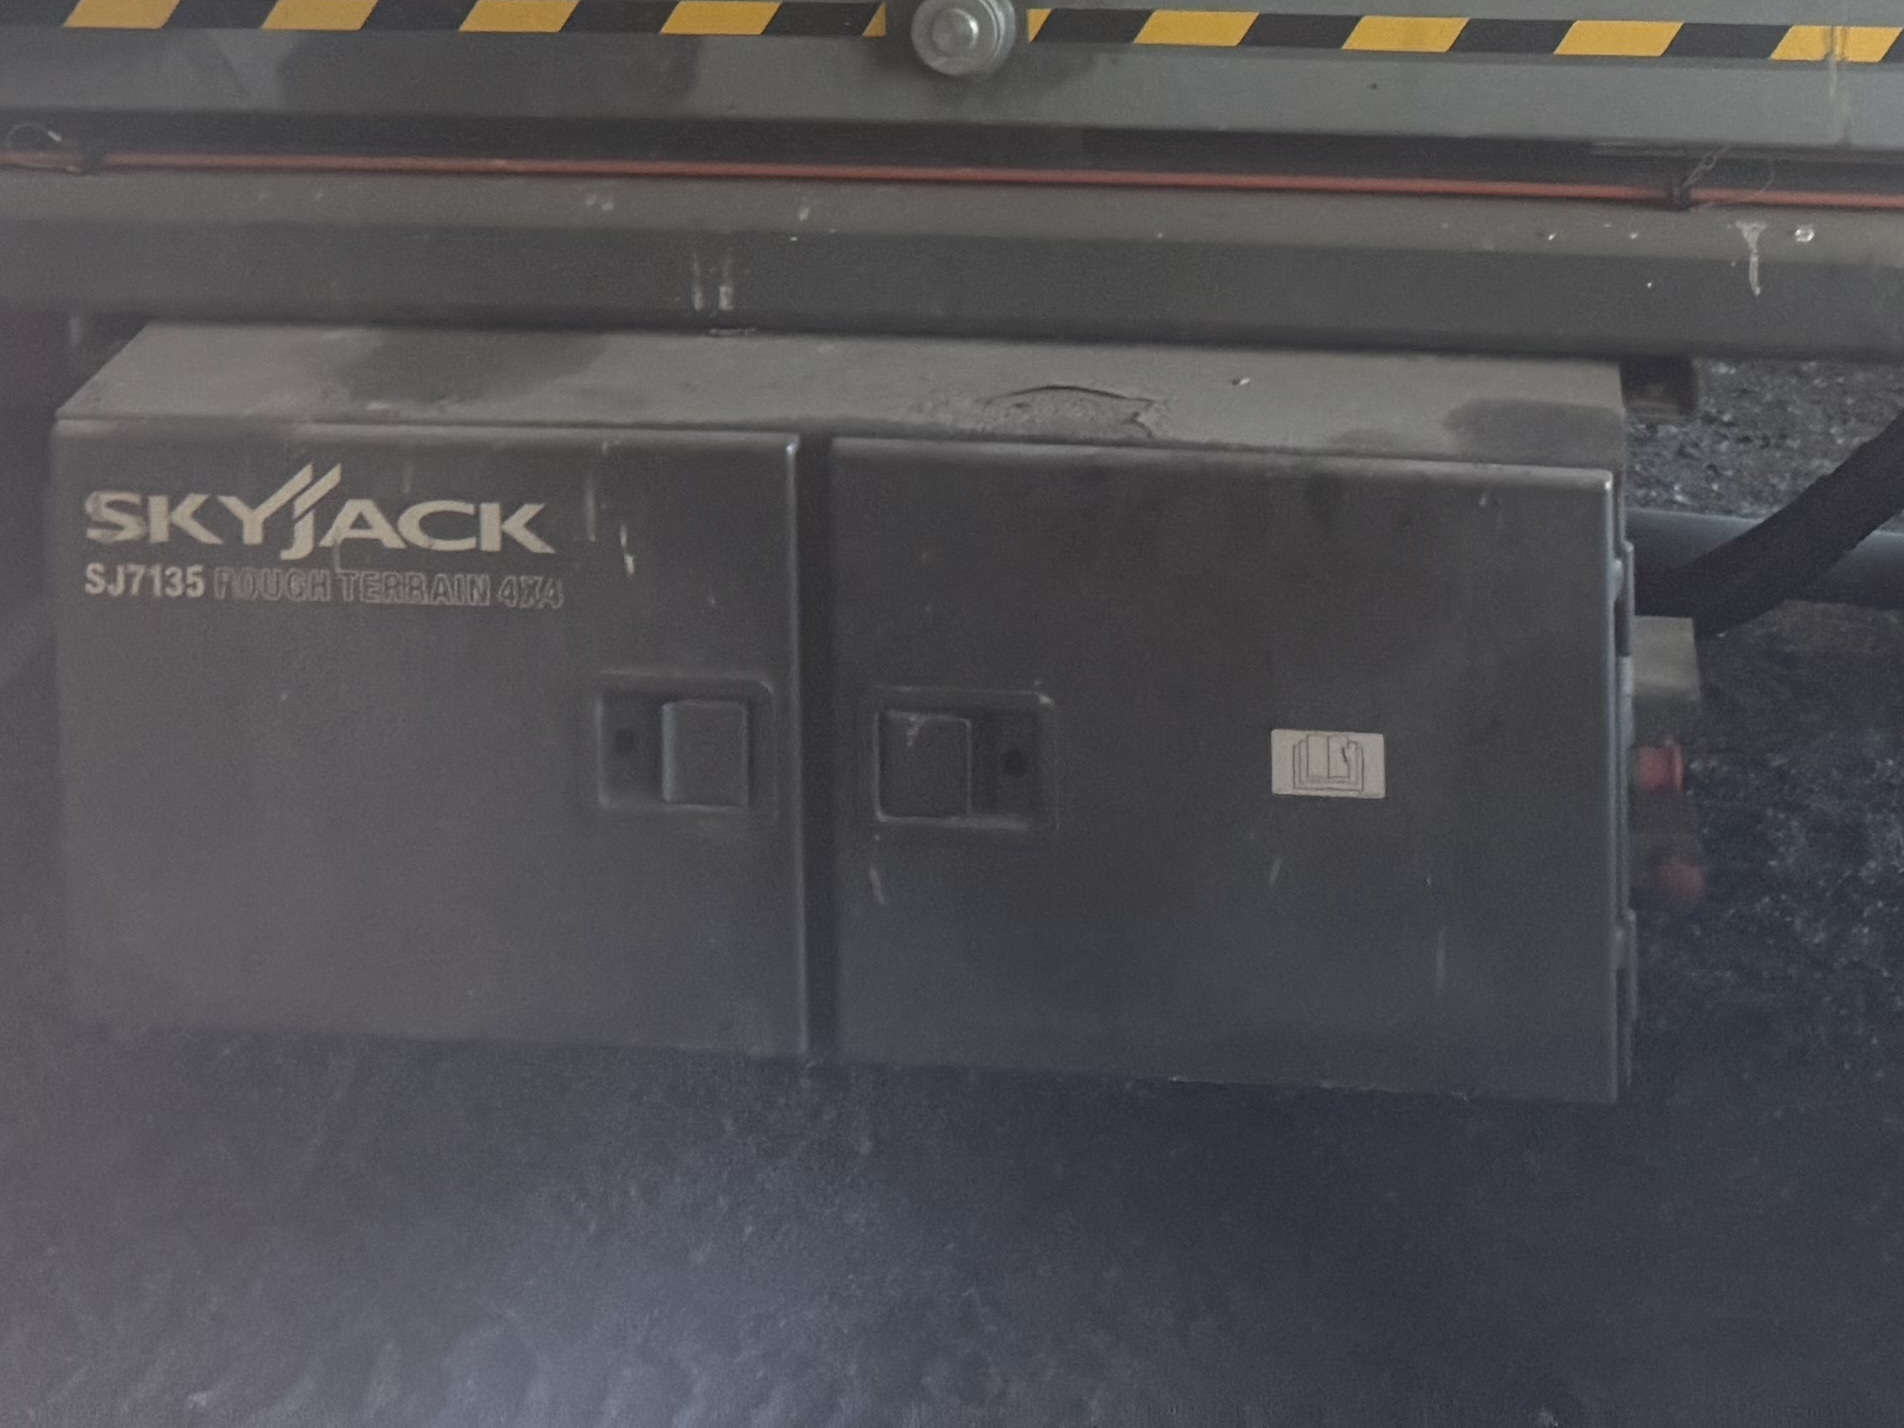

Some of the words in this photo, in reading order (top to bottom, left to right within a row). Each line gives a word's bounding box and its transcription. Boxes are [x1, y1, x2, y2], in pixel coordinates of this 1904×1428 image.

[84, 462, 556, 561] SKYJACK
[84, 563, 206, 598] SJ7135
[213, 566, 332, 603] ROUGH
[339, 570, 492, 607] TERRAIN
[498, 576, 565, 610] 4X4
